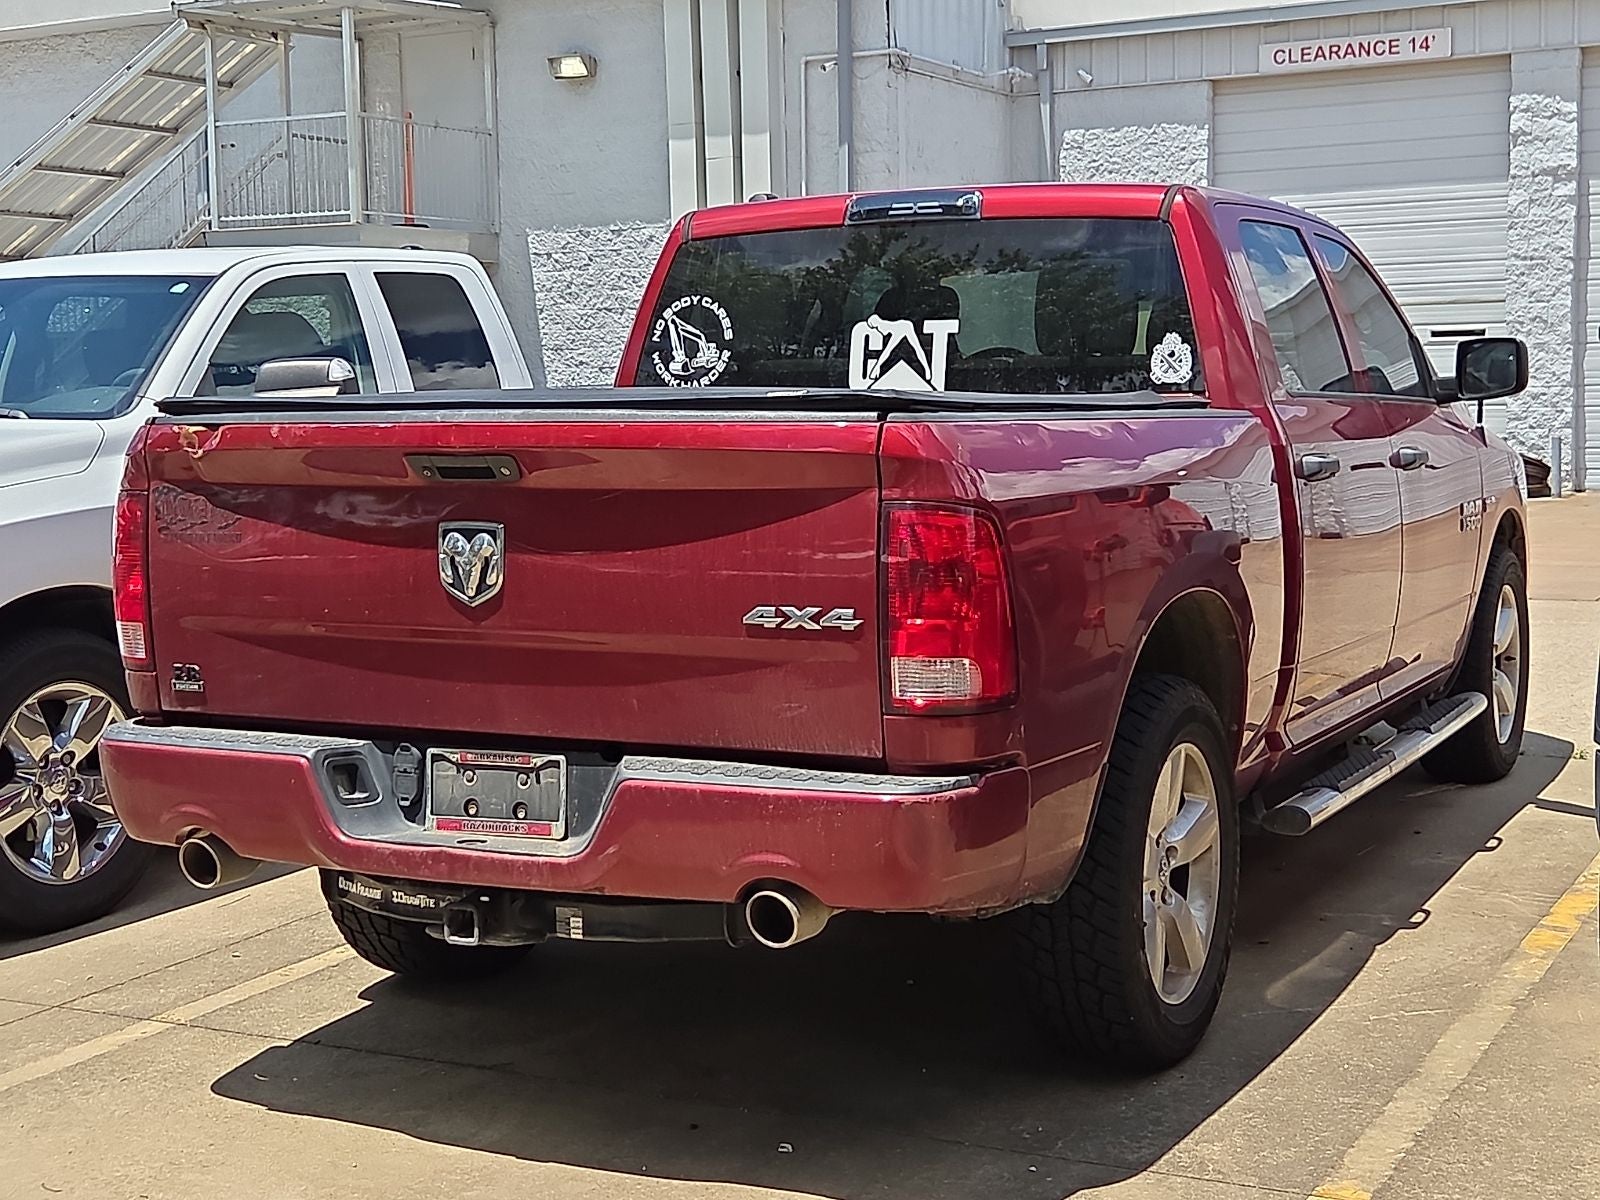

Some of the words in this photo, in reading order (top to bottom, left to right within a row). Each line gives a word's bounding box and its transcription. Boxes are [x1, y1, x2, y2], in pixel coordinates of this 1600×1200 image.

[1273, 38, 1401, 65] CLEARANCE
[1408, 35, 1436, 54] 14'
[848, 315, 960, 394] CAT
[742, 606, 865, 631] 4X4
[461, 820, 529, 833] RAZORBACKS
